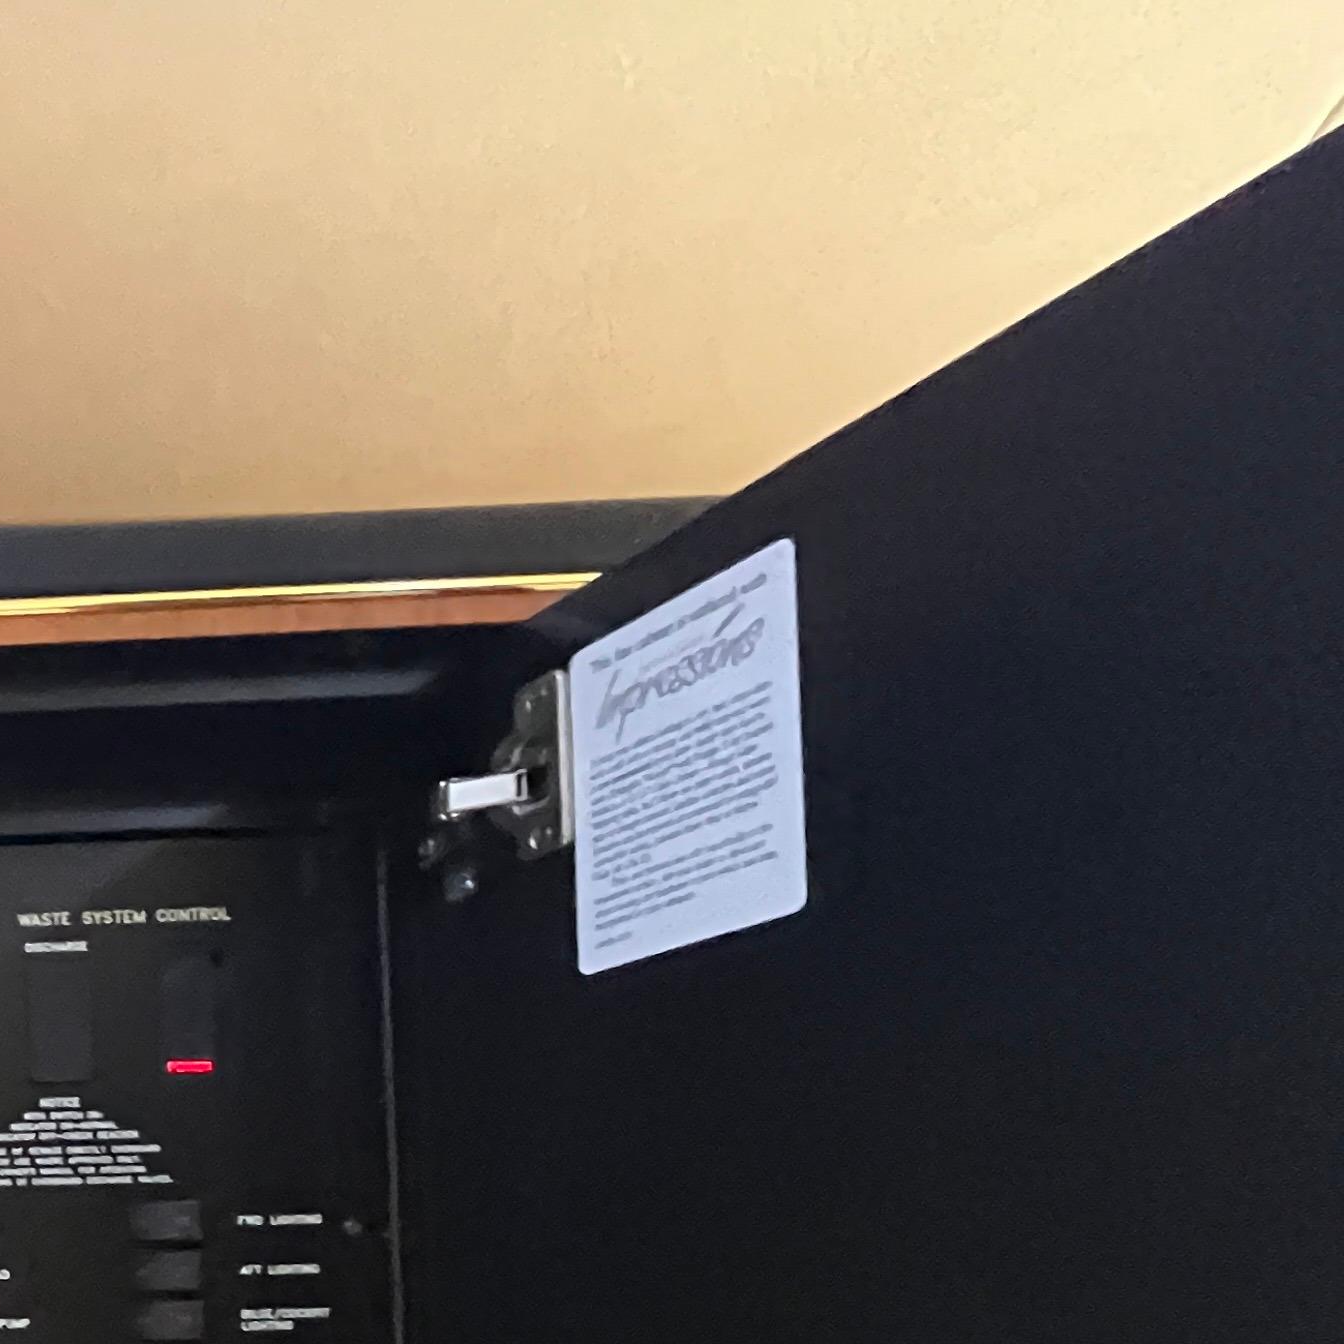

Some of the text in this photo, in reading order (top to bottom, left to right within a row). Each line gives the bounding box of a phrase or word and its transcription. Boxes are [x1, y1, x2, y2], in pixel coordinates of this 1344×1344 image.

[16, 906, 231, 927] WASTE SYSTEM CONTROL
